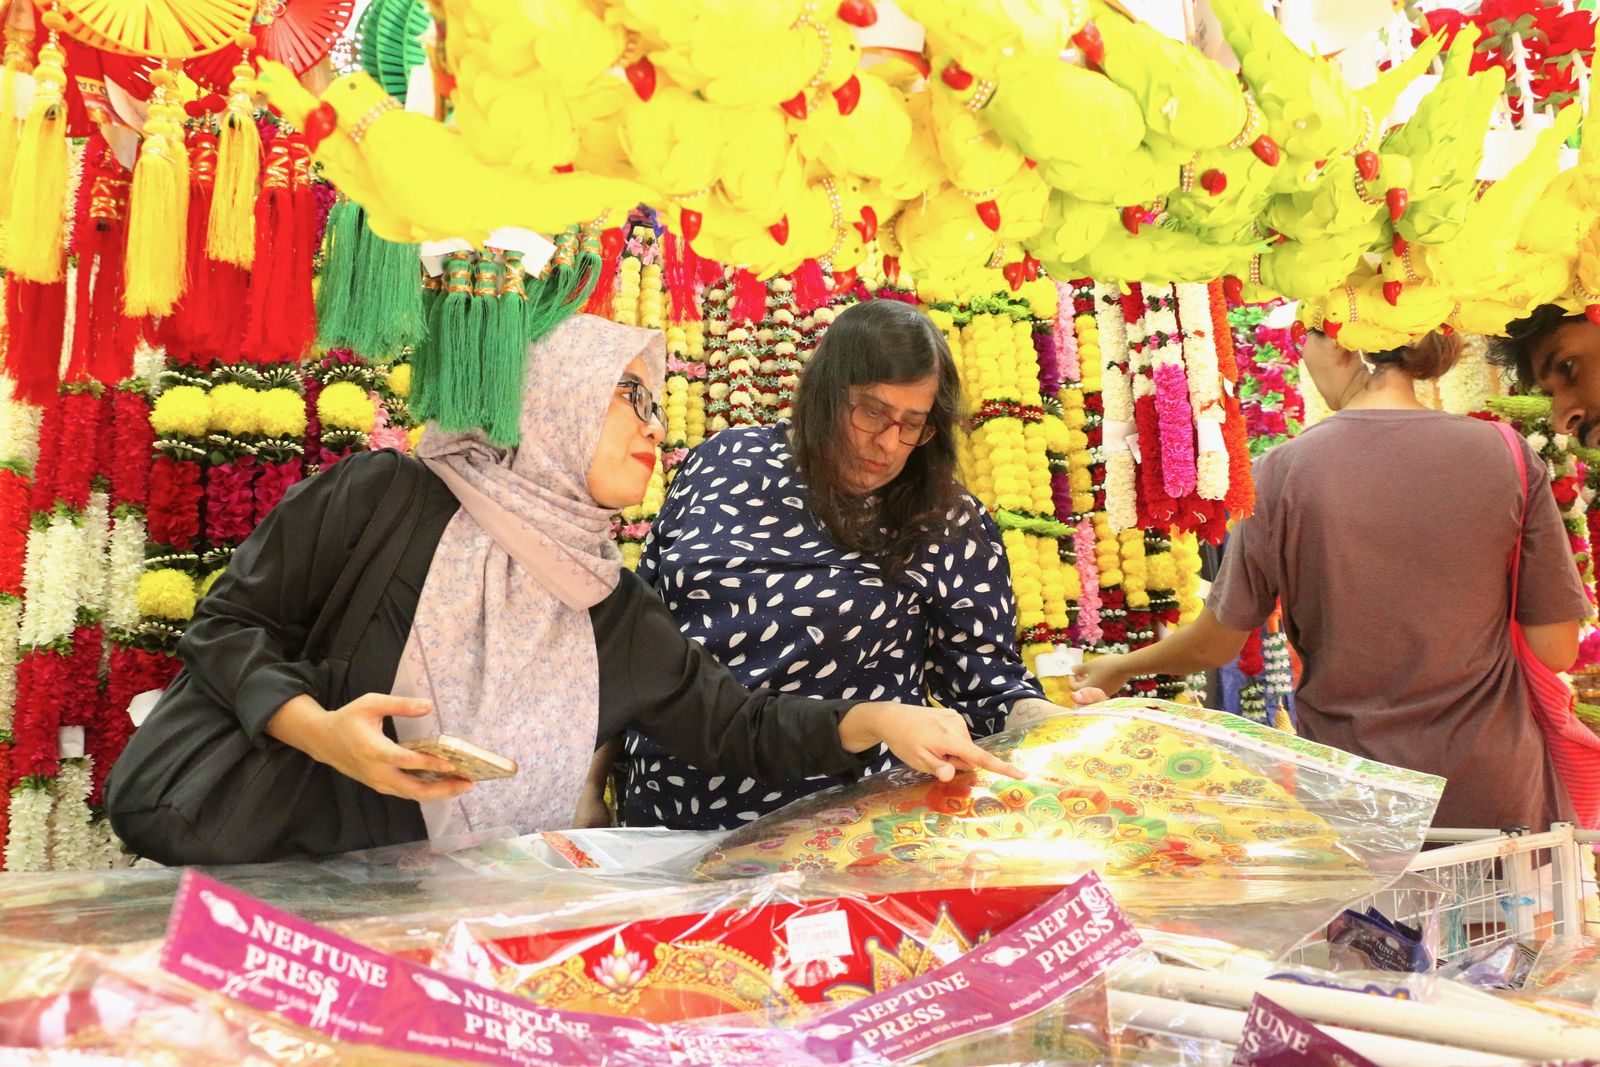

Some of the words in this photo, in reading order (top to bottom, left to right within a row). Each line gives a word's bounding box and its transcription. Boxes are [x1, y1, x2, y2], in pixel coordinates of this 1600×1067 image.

[242, 943, 339, 1003] PRESS
[250, 914, 388, 988] NEPTUNE
[1035, 917, 1115, 974] PRESS
[848, 971, 970, 1028] NEPTUNE
[861, 1003, 946, 1048] PRESS
[903, 1036, 915, 1048] To
[914, 1030, 932, 1043] Life
